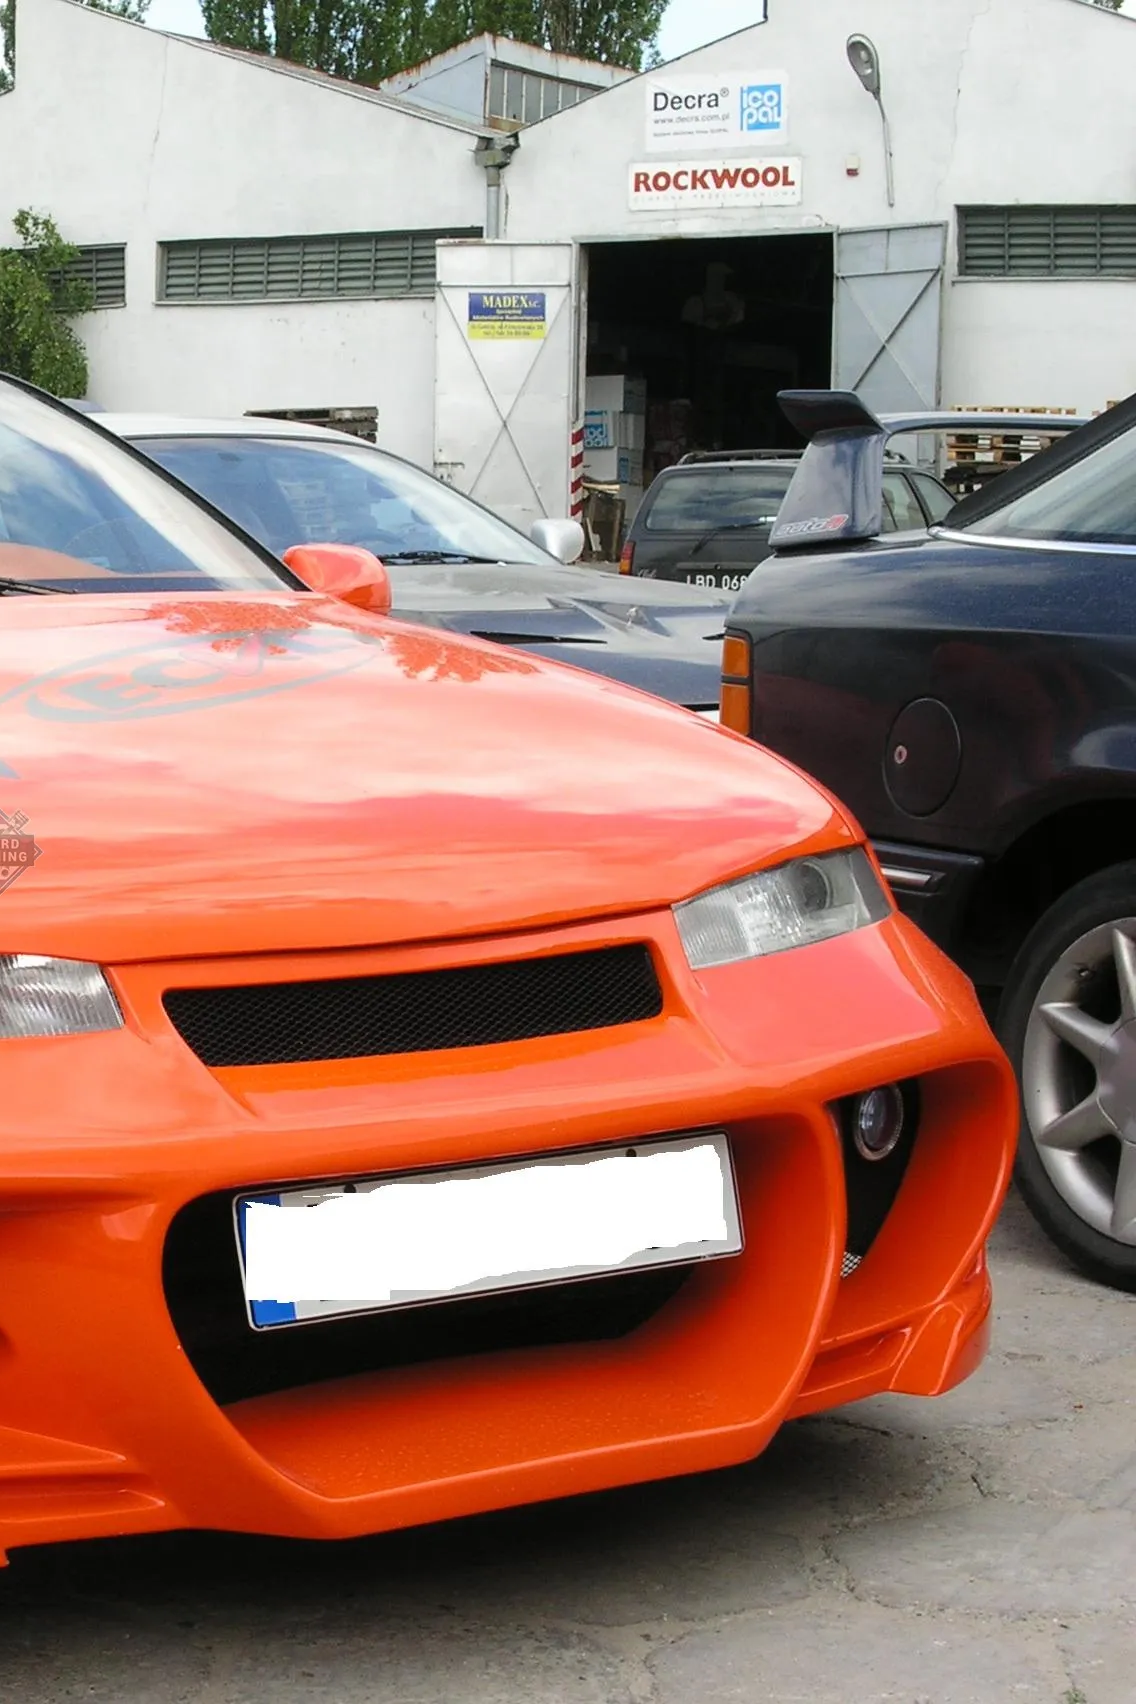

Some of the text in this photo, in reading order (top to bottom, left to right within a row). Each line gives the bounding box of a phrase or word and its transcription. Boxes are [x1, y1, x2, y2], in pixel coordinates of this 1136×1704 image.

[653, 113, 730, 125] www.decra.com.pl
[634, 166, 795, 192] ROCKWOOL
[482, 295, 529, 308] MADEX
